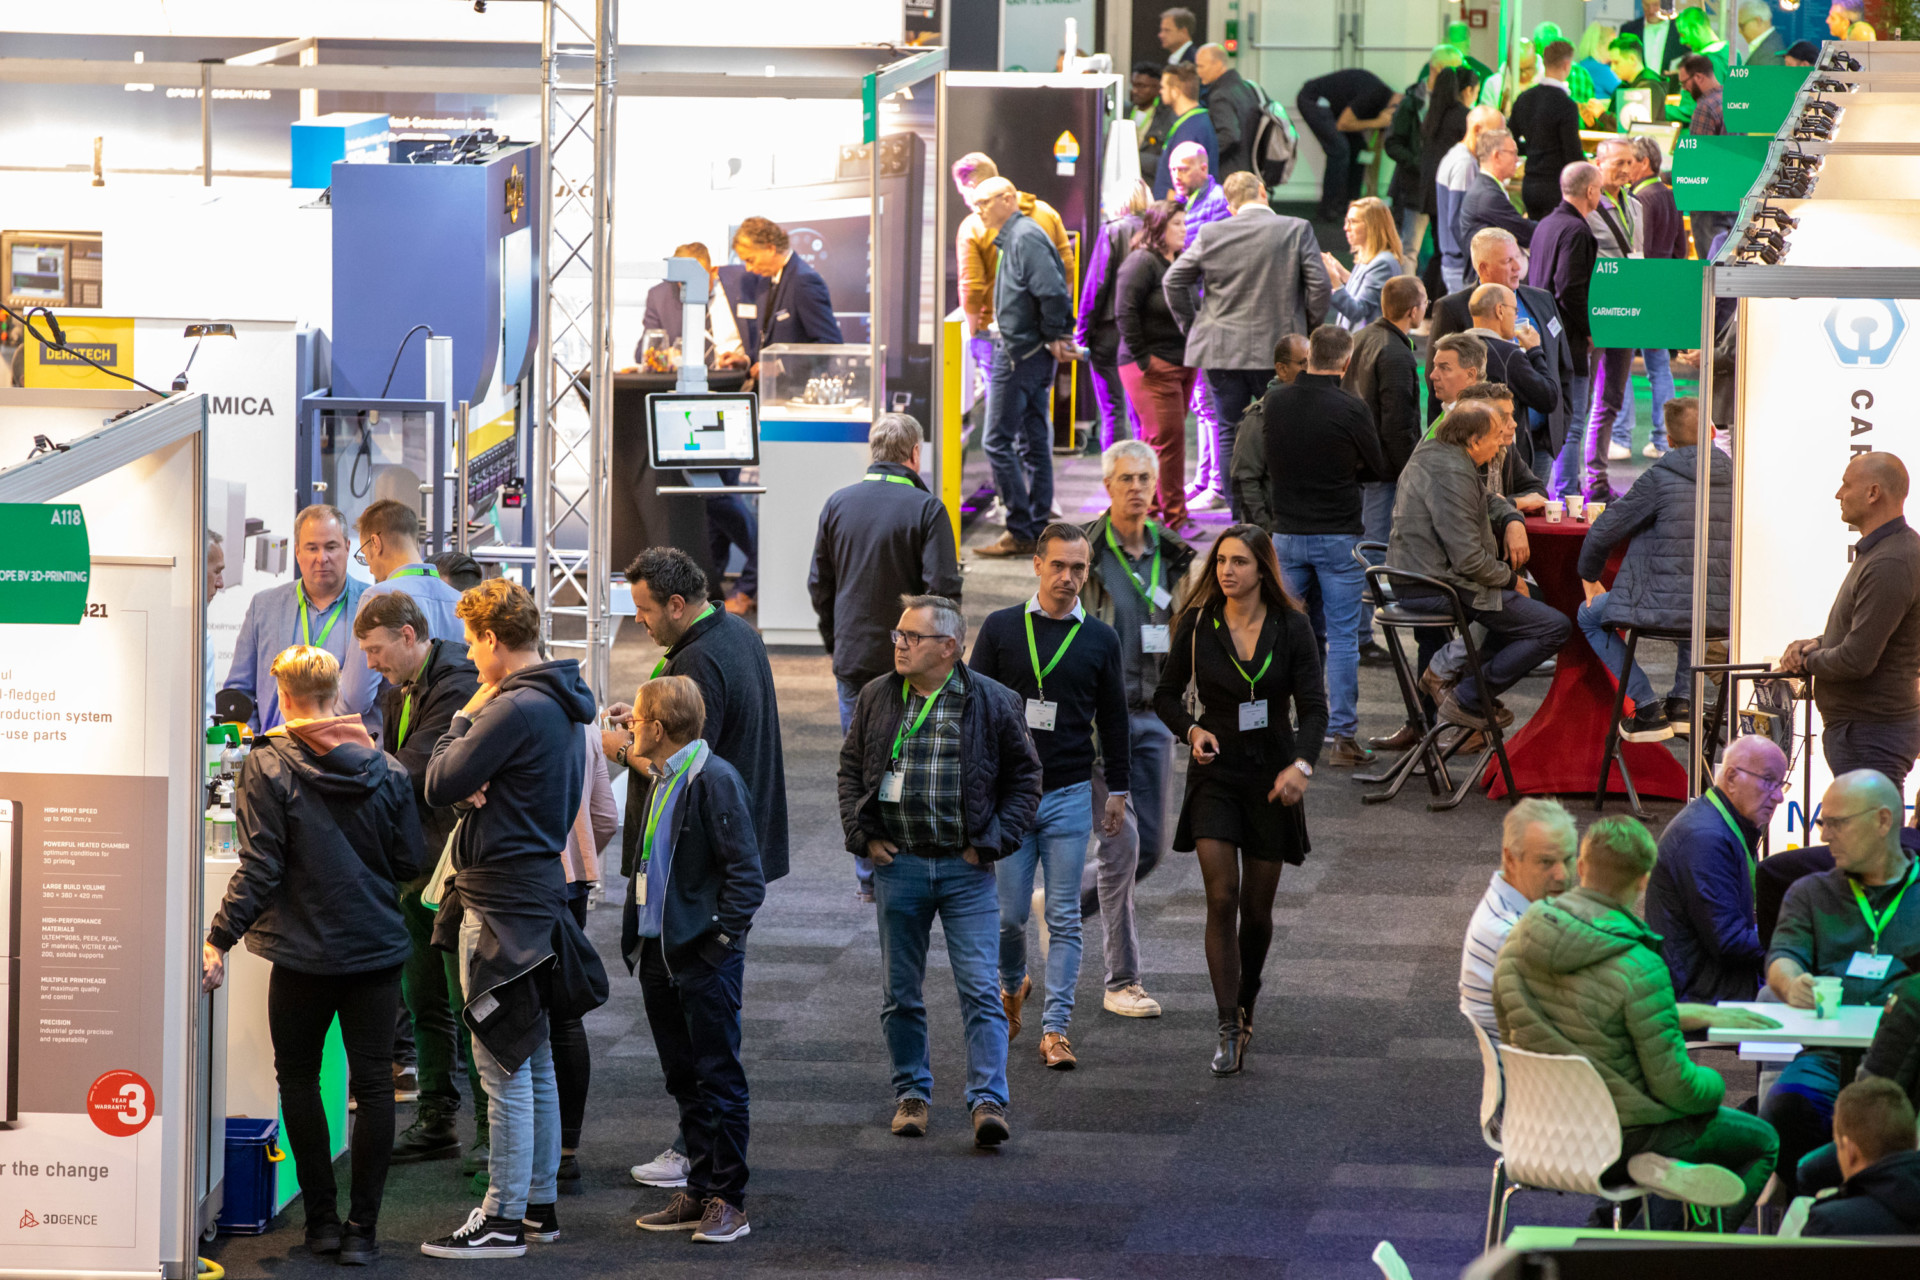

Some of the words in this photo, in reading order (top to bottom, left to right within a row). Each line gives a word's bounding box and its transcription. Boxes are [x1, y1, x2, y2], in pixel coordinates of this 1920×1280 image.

[1730, 68, 1749, 78] A109
[1678, 138, 1698, 149] A113
[1676, 176, 1700, 184] PROMAS
[1701, 176, 1710, 184] BV
[1596, 261, 1619, 274] A115
[1591, 306, 1630, 316] CARMITECH
[1631, 307, 1642, 316] BV
[46, 347, 112, 361] DERATECH
[50, 509, 82, 525] A118
[18, 570, 30, 582] BV
[30, 570, 88, 582] 3D-PRINTING
[66, 711, 113, 725] system
[33, 730, 67, 743] parts
[77, 841, 100, 849] HEATED
[101, 842, 130, 850] CHAMBER
[53, 858, 76, 866] printing
[41, 917, 102, 925] HIGH-PERFORMANCE
[79, 952, 104, 960] supports
[69, 977, 107, 985] PRINTHEADS
[80, 986, 101, 994] quality
[40, 1018, 72, 1026] PRECISION
[68, 1028, 85, 1036] grade
[52, 1036, 89, 1044] repeatability
[117, 1083, 146, 1125] 3
[12, 1161, 39, 1177] the
[46, 1161, 109, 1182] change
[43, 1213, 98, 1226] 3DGENCE
